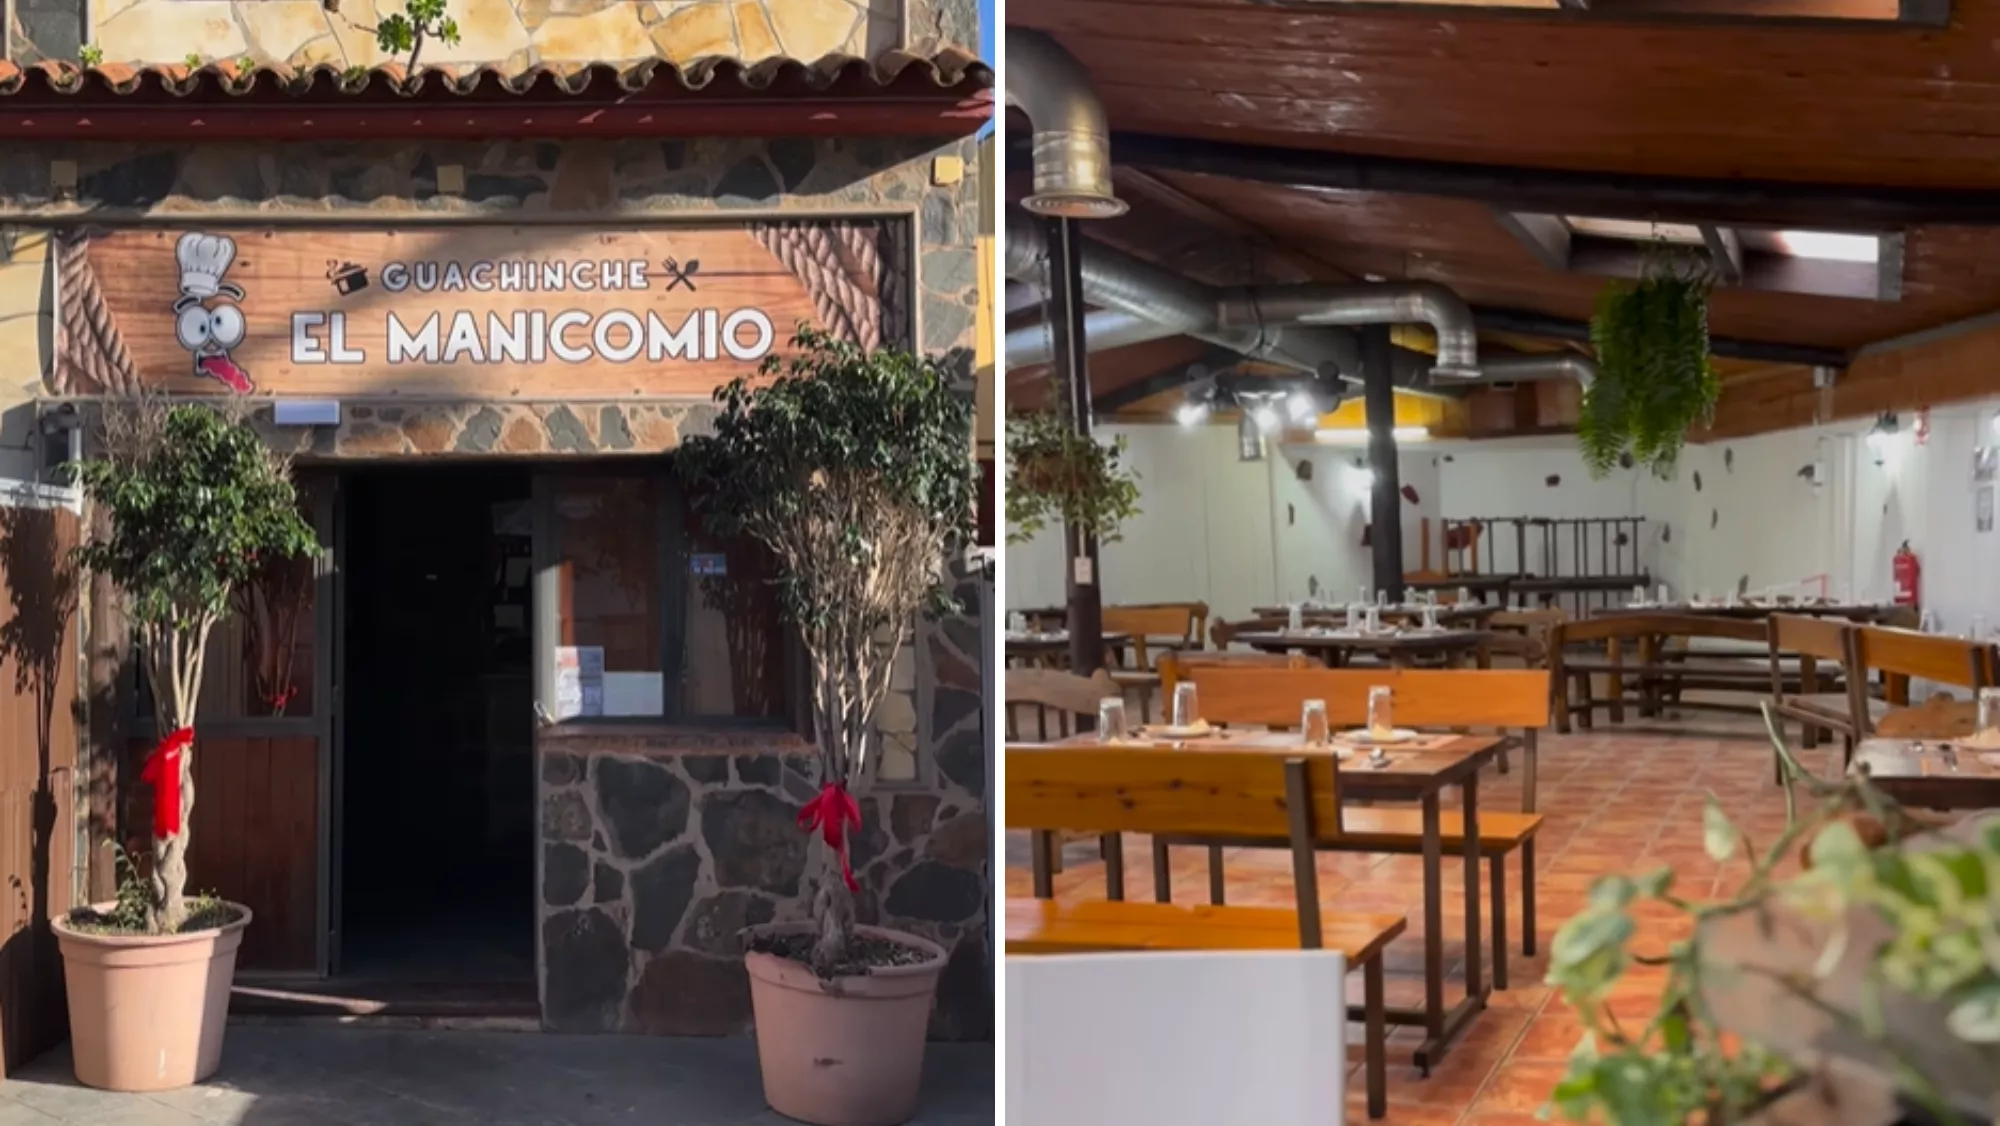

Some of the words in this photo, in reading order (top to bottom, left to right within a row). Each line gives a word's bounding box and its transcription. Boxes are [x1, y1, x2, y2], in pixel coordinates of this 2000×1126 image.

[381, 259, 650, 292] GUACHINCHE
[291, 311, 365, 365] EL
[386, 307, 774, 363] MANICOMIO
